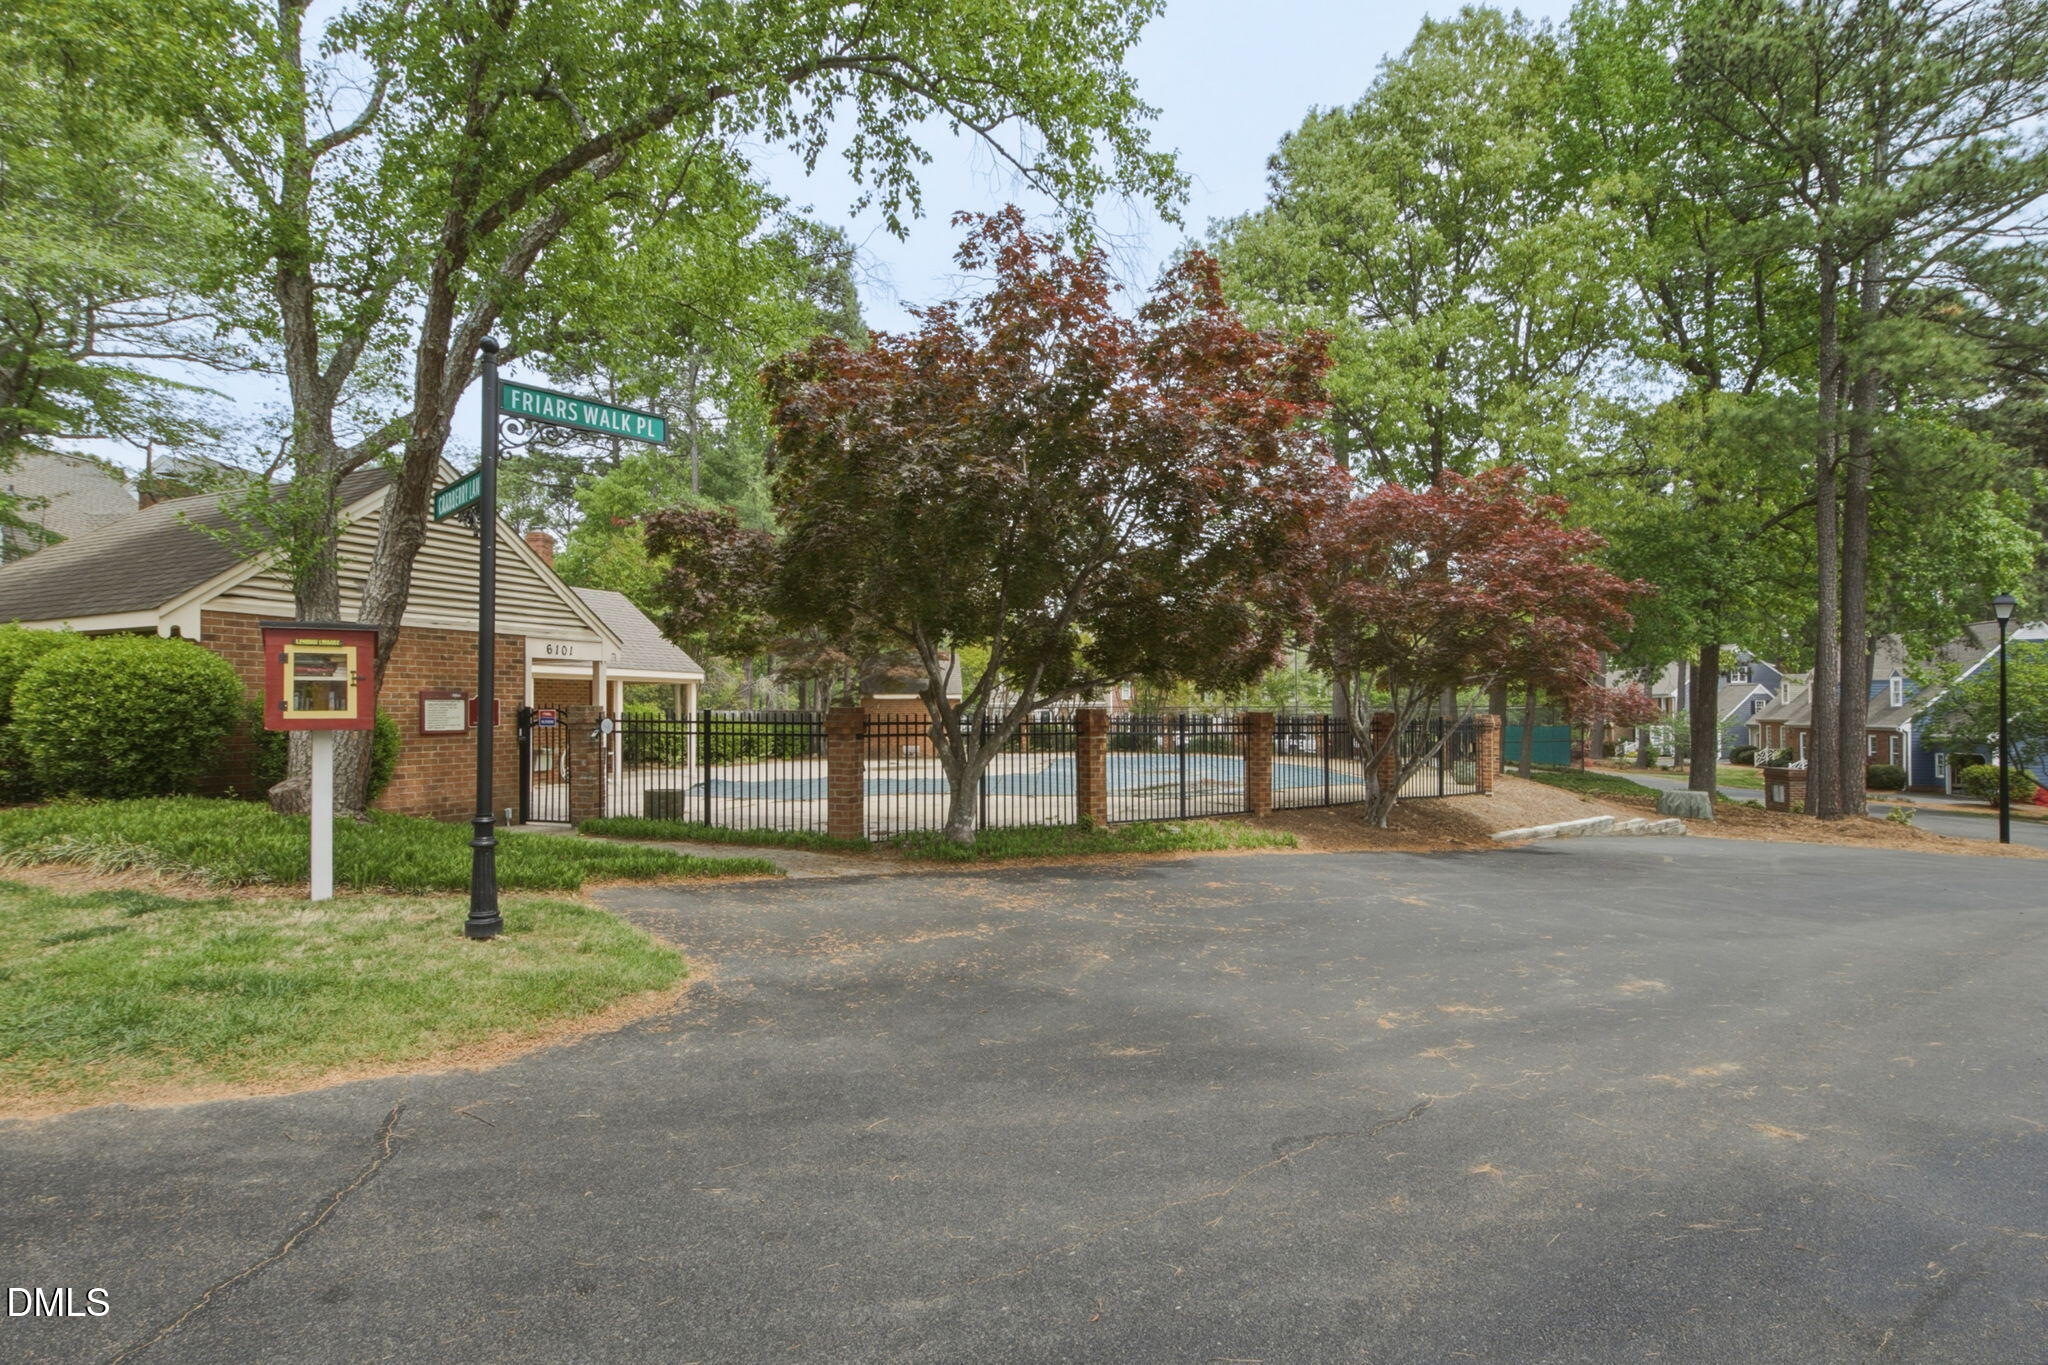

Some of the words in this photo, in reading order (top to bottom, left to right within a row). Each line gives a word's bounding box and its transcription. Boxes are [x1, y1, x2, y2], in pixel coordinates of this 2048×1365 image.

[511, 389, 578, 421] FRIARS
[583, 405, 631, 433] WALK
[636, 416, 655, 437] PL
[469, 475, 481, 500] LAN
[546, 643, 573, 656] 6101
